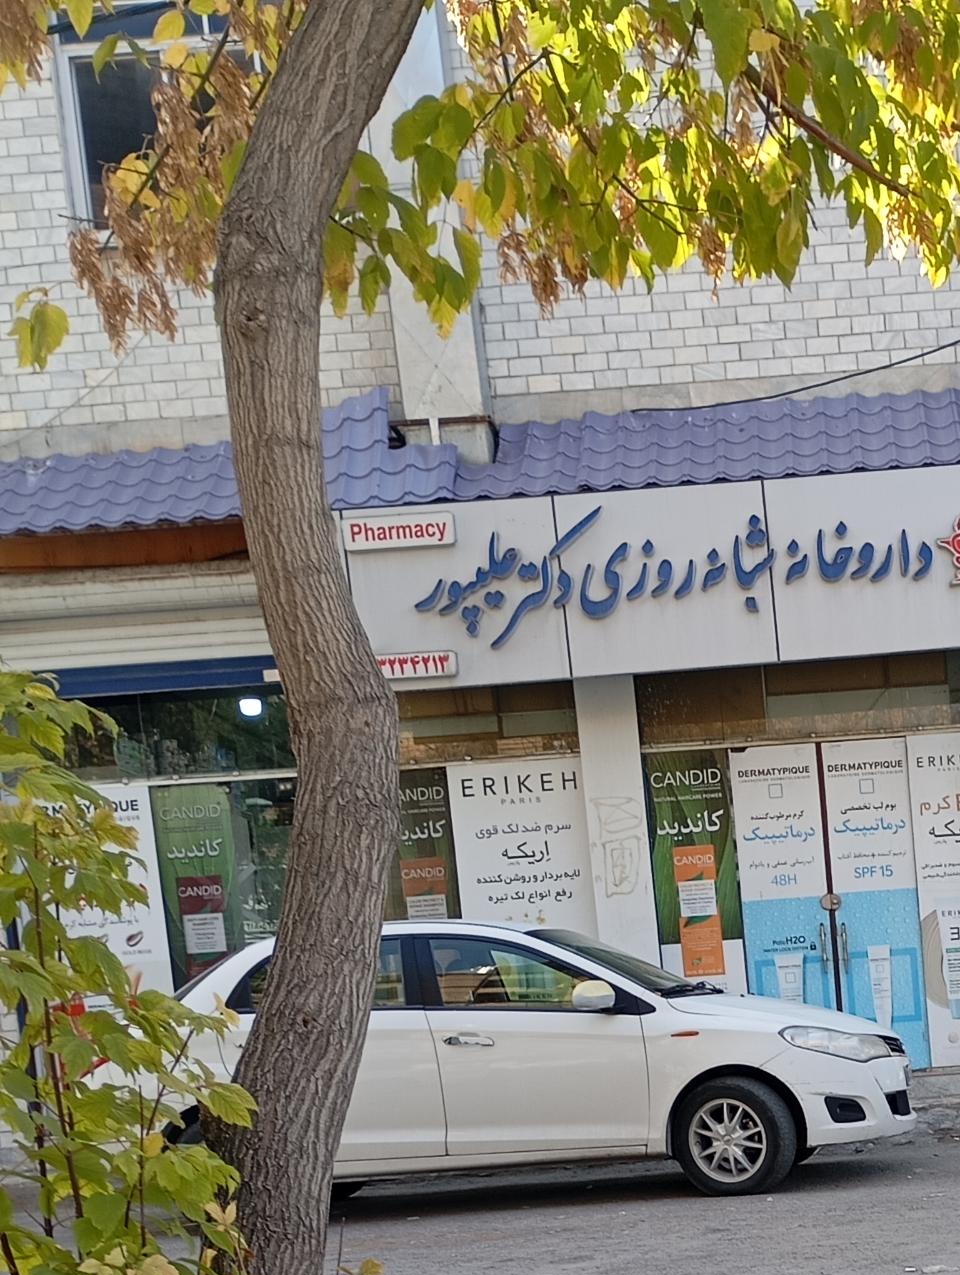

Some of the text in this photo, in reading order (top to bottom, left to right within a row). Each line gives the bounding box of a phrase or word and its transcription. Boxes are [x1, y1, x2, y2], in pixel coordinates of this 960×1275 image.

[350, 521, 448, 543] Pharmacy
[785, 519, 934, 586] داروخانه
[490, 505, 602, 651] دکتر
[737, 765, 810, 778] DERMATYPIQUE
[827, 759, 904, 773] DERMATYPIQUE
[461, 771, 578, 798] ERIKEH
[650, 768, 721, 788] CANDID
[400, 786, 444, 801] ANDID
[500, 796, 541, 805] PARIS
[159, 804, 222, 821] CANDID
[920, 795, 951, 816] کرم
[501, 823, 520, 834] لک
[544, 822, 572, 835] سرم
[656, 809, 724, 840] کاندید
[401, 820, 447, 845] کاندی
[475, 825, 498, 840] قوی
[167, 838, 223, 863] کاندید
[674, 854, 714, 866] CANDID
[402, 867, 445, 880] CANDID
[854, 864, 894, 879] SPF 15
[770, 873, 798, 886] 48H
[178, 885, 222, 898] CANDID
[488, 888, 573, 905] رفع انواع لک تیره
